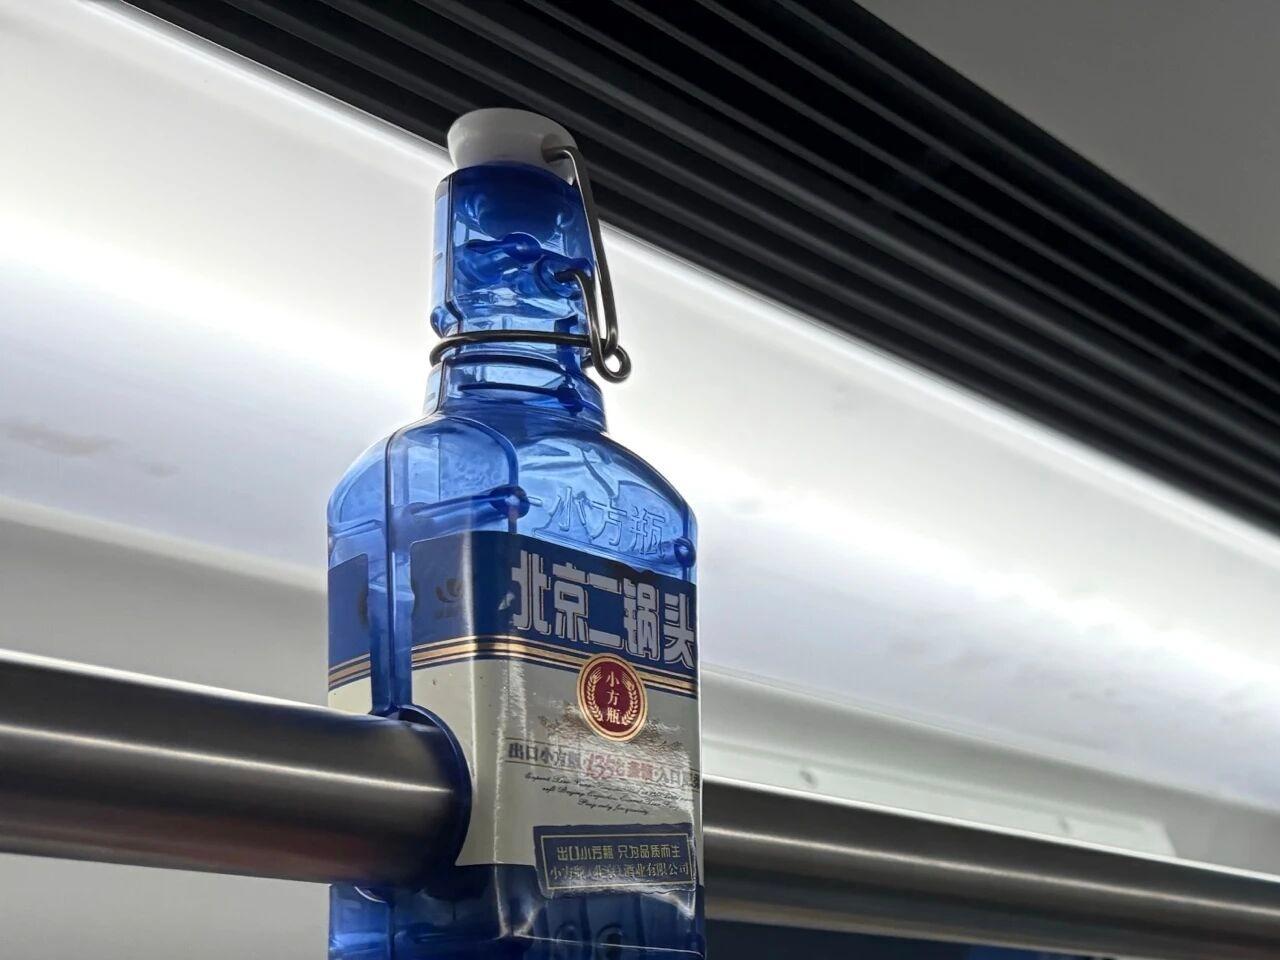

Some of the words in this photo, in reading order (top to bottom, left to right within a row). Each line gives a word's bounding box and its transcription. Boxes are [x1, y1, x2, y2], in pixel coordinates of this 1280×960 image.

[549, 486, 666, 556] 小方瓶
[511, 550, 697, 670] 北京二锅头
[605, 671, 622, 725] 小方瓶
[618, 844, 681, 859] 只为品质而生
